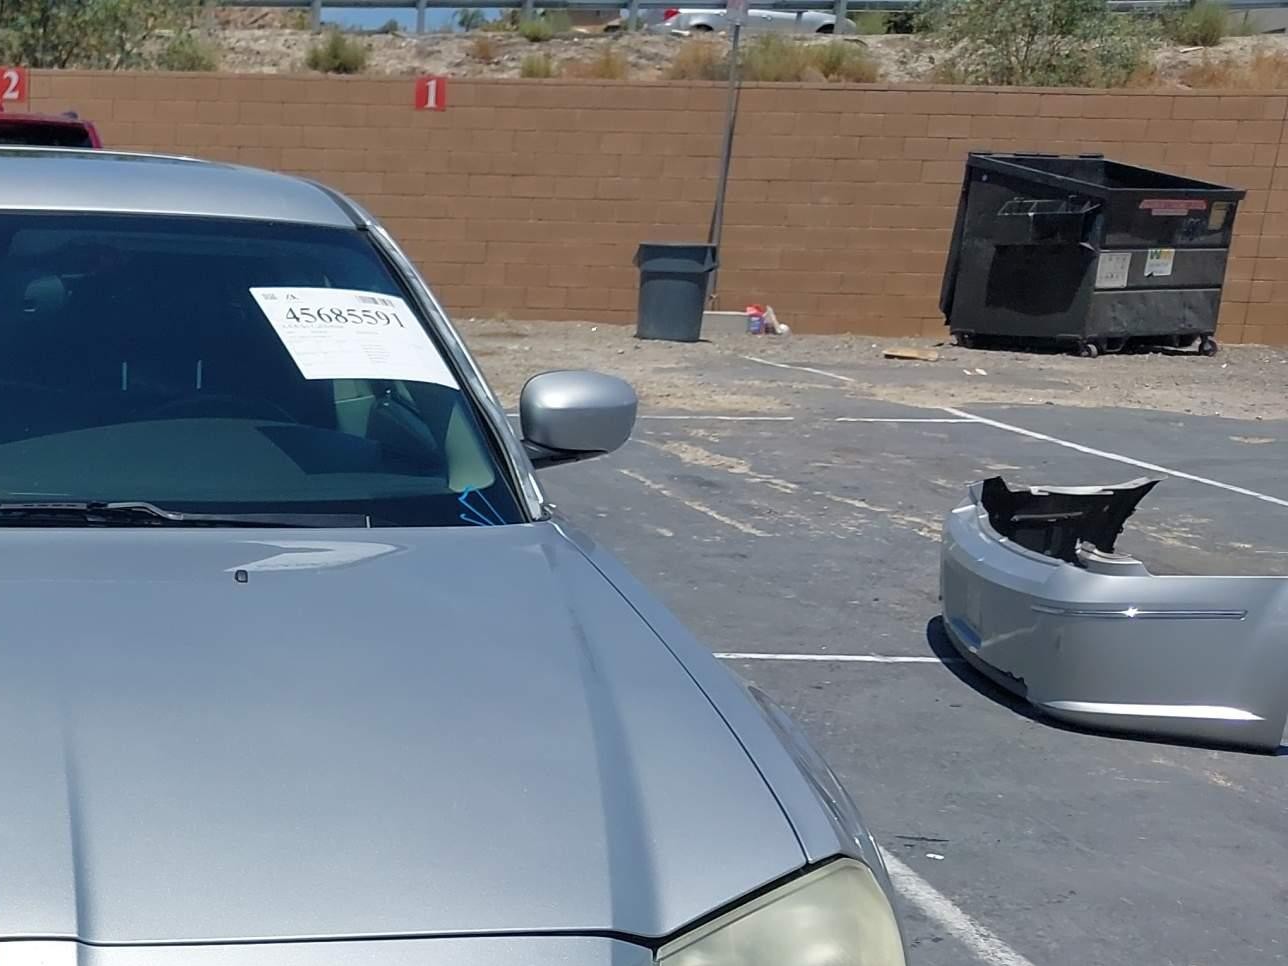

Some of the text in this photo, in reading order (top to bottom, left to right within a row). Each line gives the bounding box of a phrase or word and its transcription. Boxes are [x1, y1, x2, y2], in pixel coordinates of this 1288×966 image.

[2, 70, 20, 99] 2
[425, 79, 438, 108] 1
[285, 307, 406, 329] 45685591
